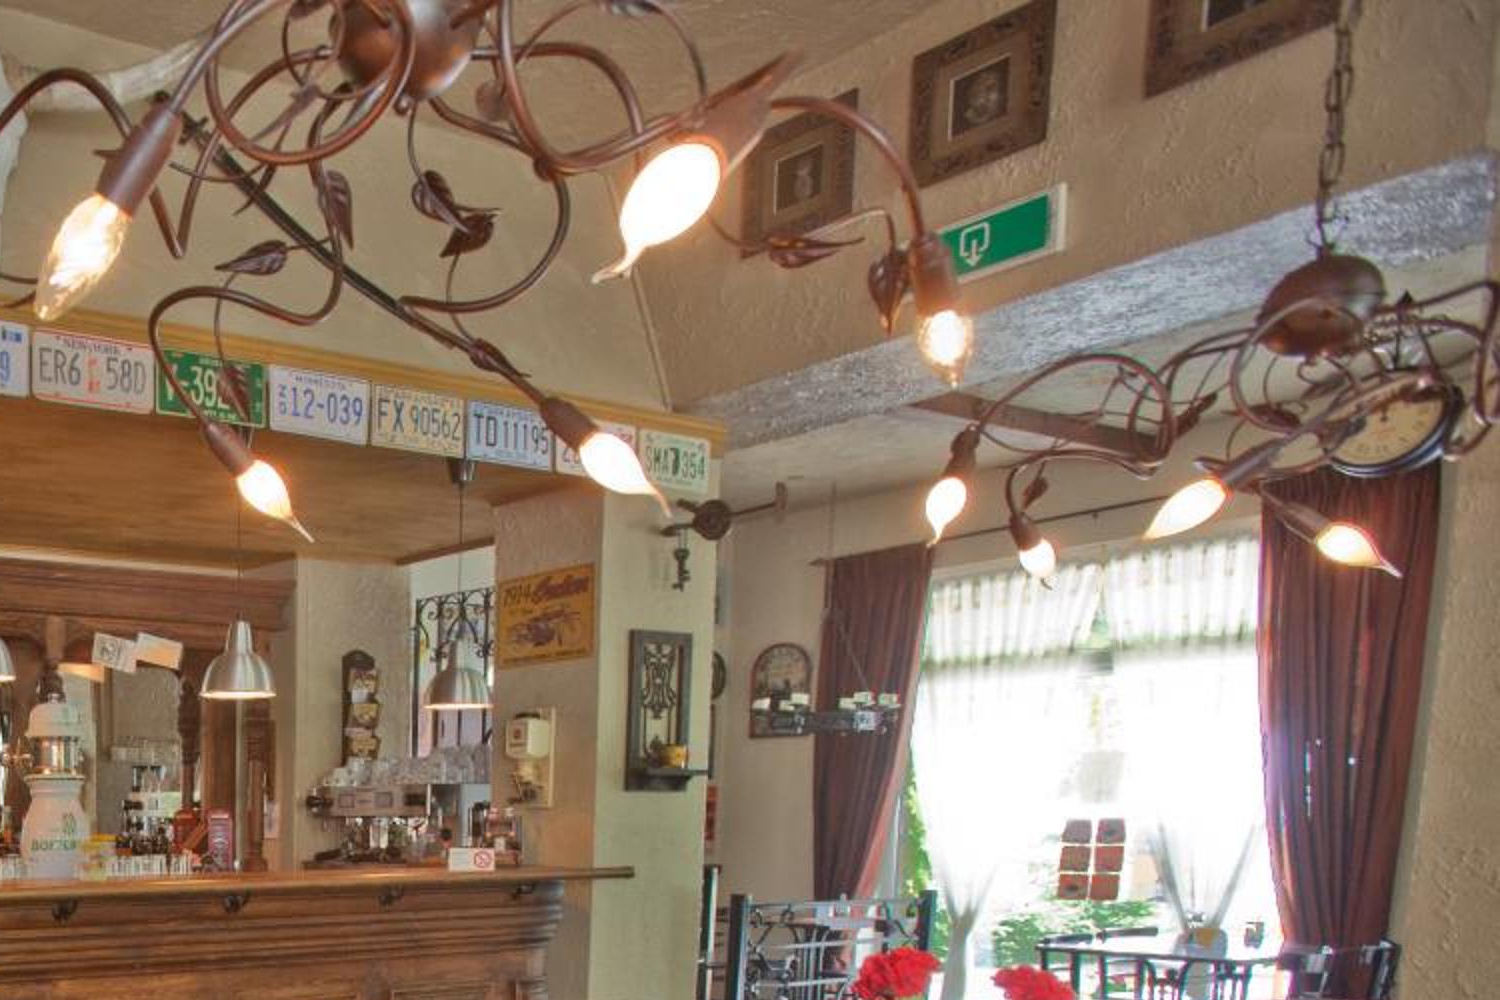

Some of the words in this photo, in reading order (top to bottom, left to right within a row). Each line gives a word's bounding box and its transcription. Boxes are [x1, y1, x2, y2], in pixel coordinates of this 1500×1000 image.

[39, 347, 81, 386] ER6
[291, 387, 363, 426] 12-039
[378, 398, 404, 432] FX
[411, 405, 461, 441] 90562
